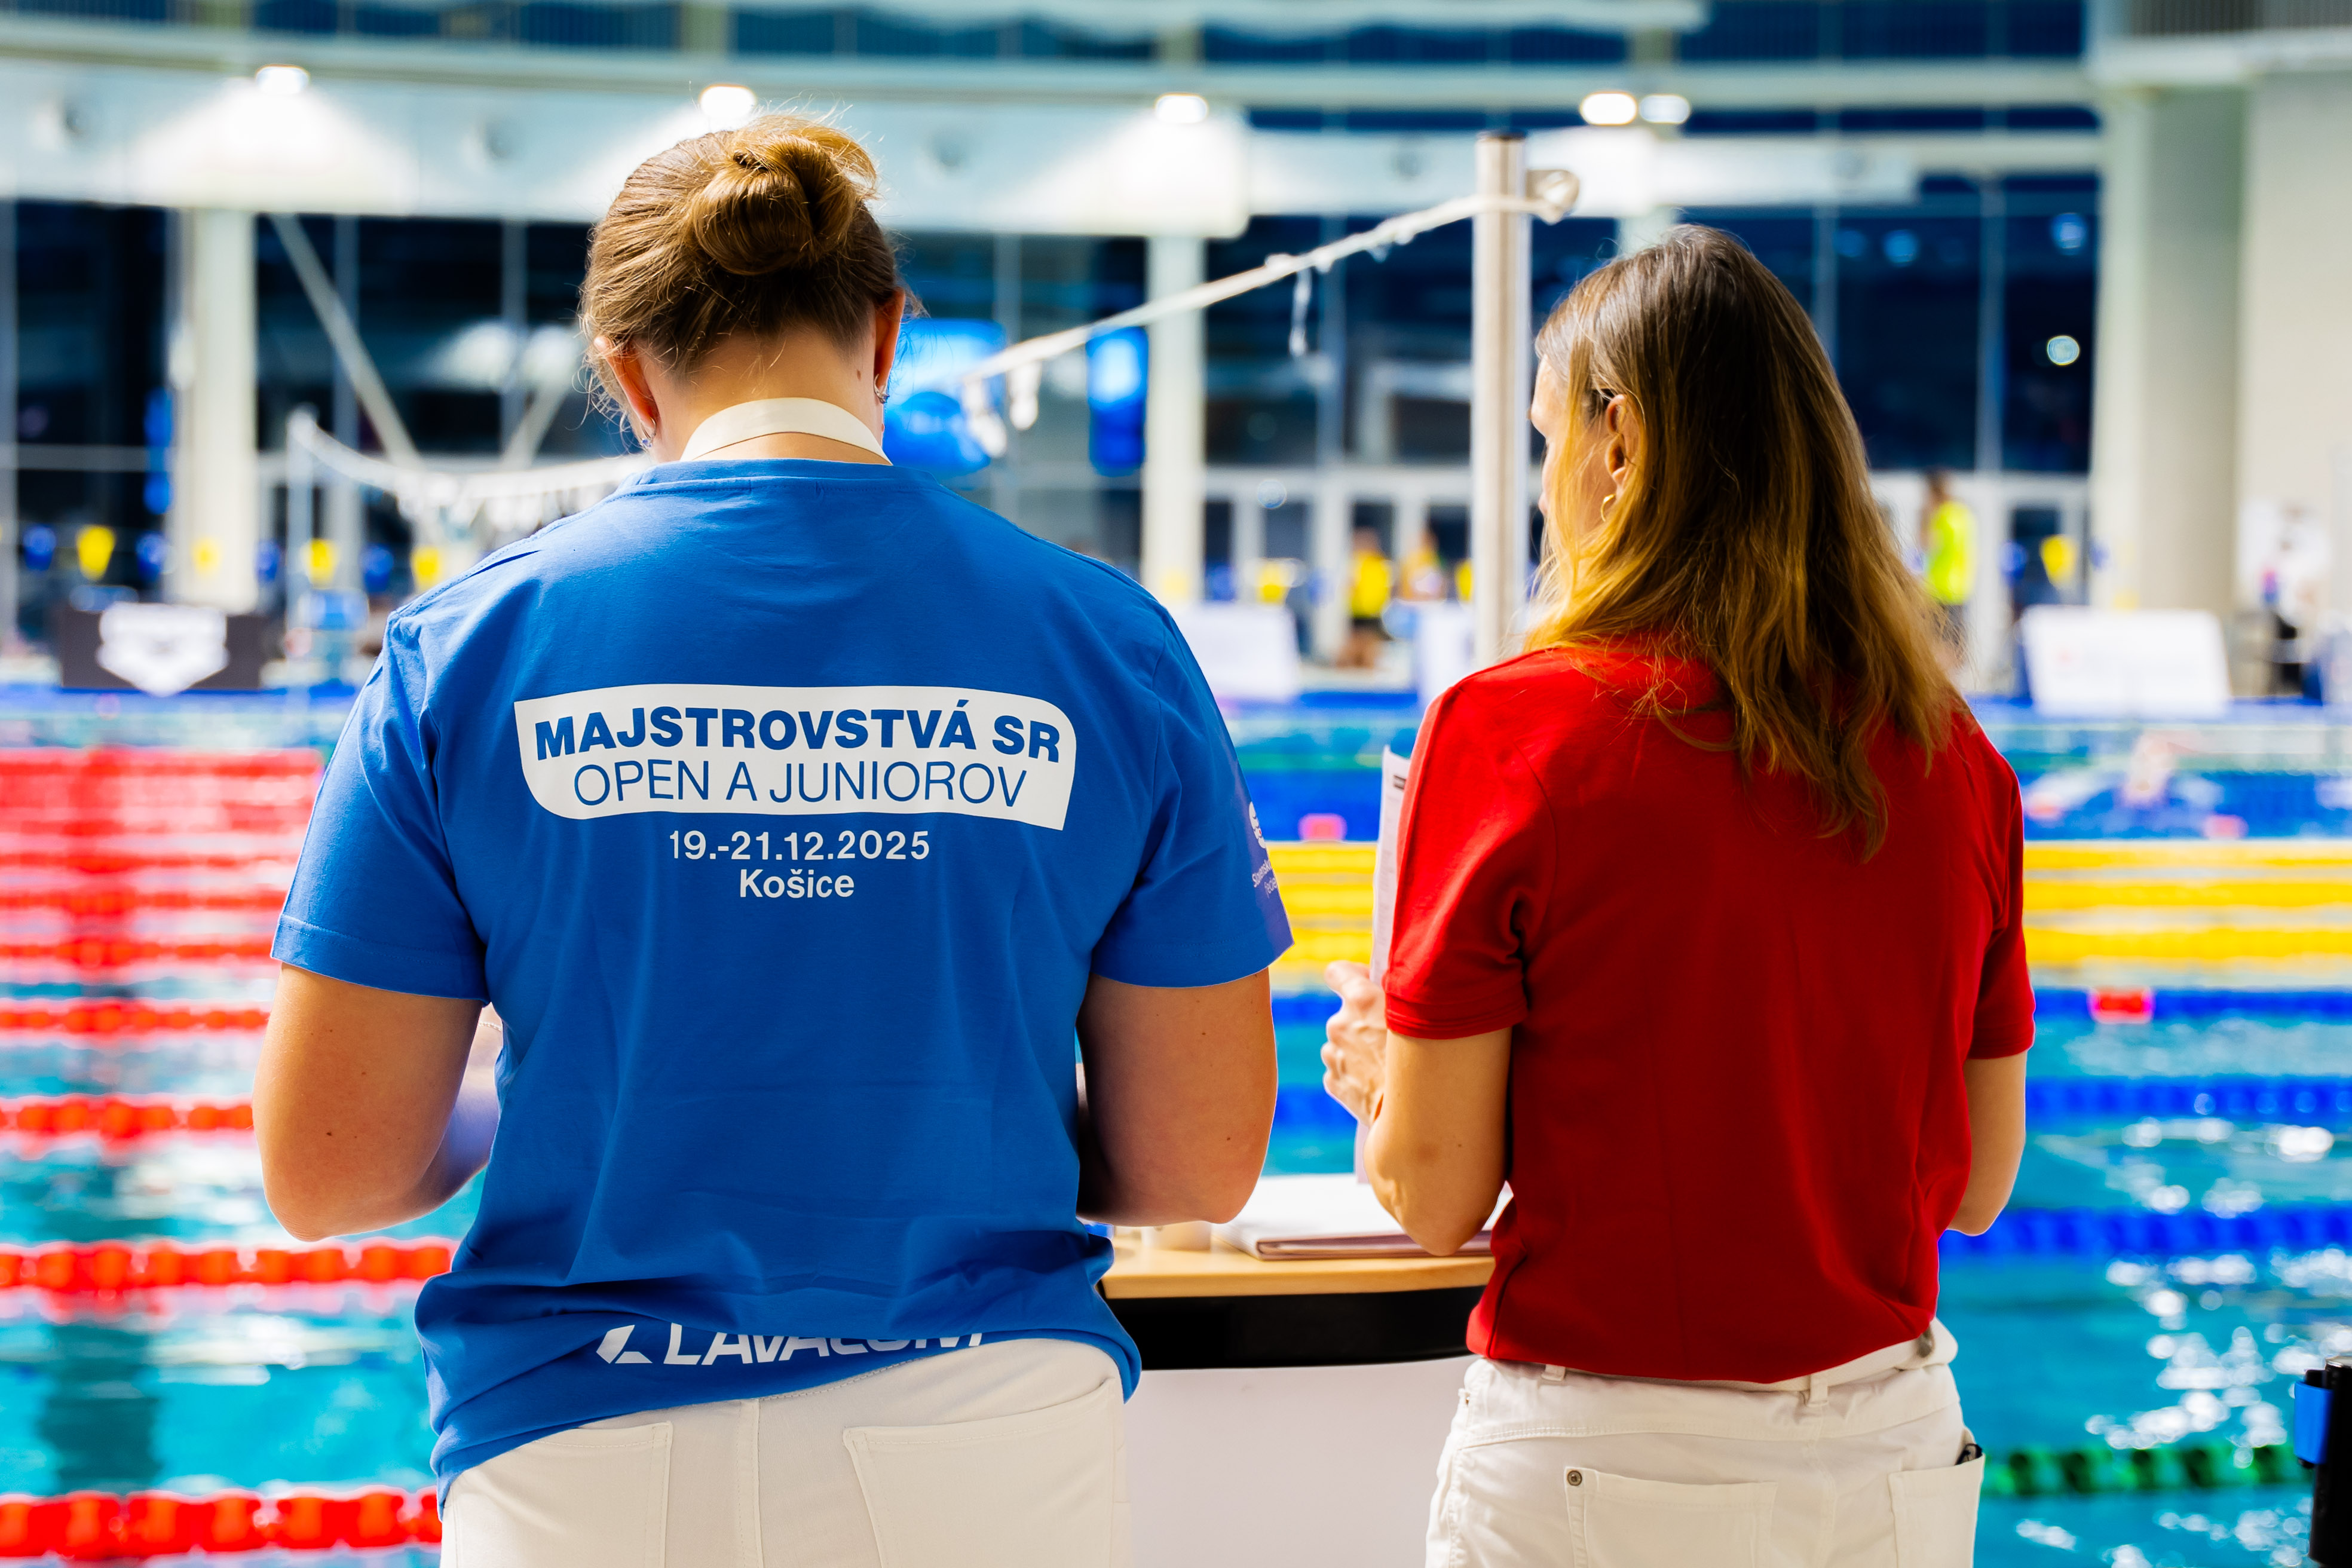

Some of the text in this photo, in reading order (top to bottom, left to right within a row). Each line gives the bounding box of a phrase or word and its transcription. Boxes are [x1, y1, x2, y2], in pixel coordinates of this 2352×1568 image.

[535, 699, 1060, 763] MAJSTROVSTVÁ SR
[574, 759, 1027, 807] OPEN A JUNIOROV
[669, 830, 929, 860] 19.-21.12.2025
[740, 869, 855, 898] Košice
[663, 1322, 982, 1365] LAVA
